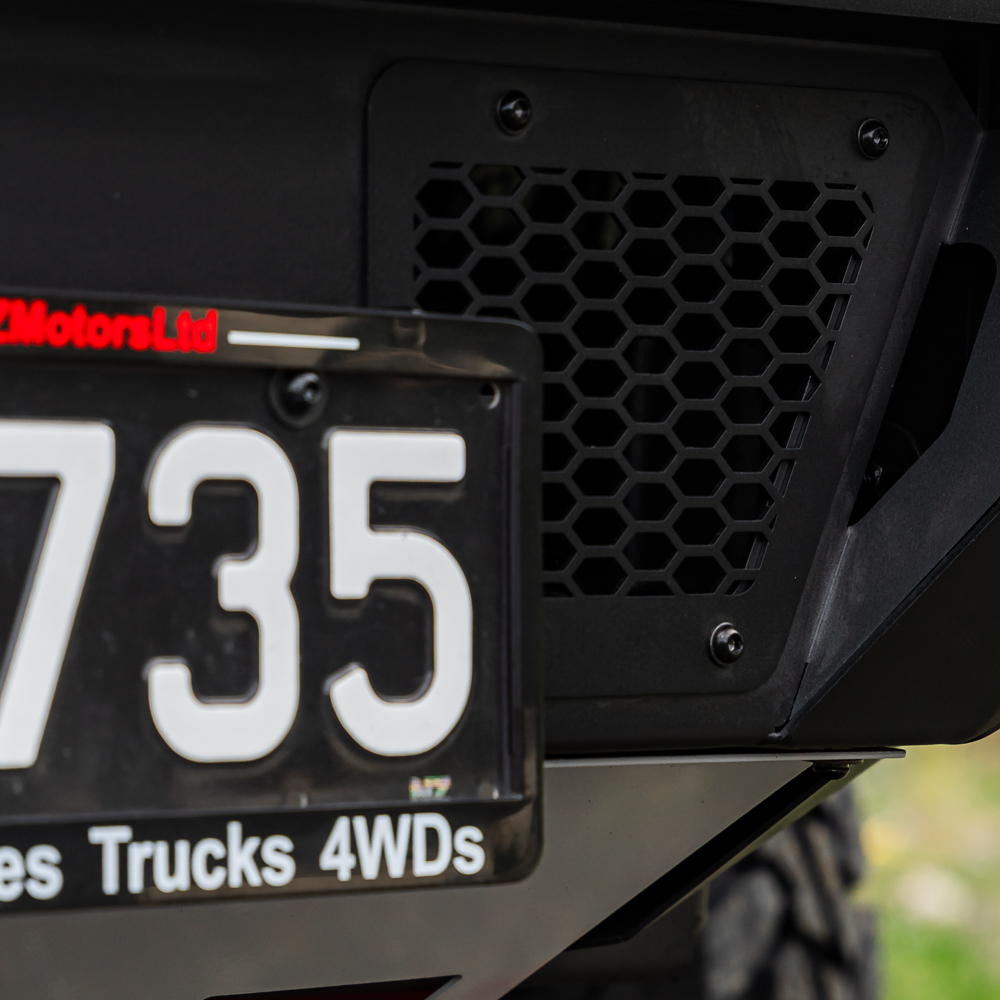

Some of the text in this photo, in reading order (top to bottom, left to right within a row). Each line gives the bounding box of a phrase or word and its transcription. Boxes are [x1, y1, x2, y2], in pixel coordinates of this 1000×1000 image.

[0, 419, 473, 769] 735
[88, 820, 297, 896] Trucks
[318, 811, 487, 883] 4WDs
